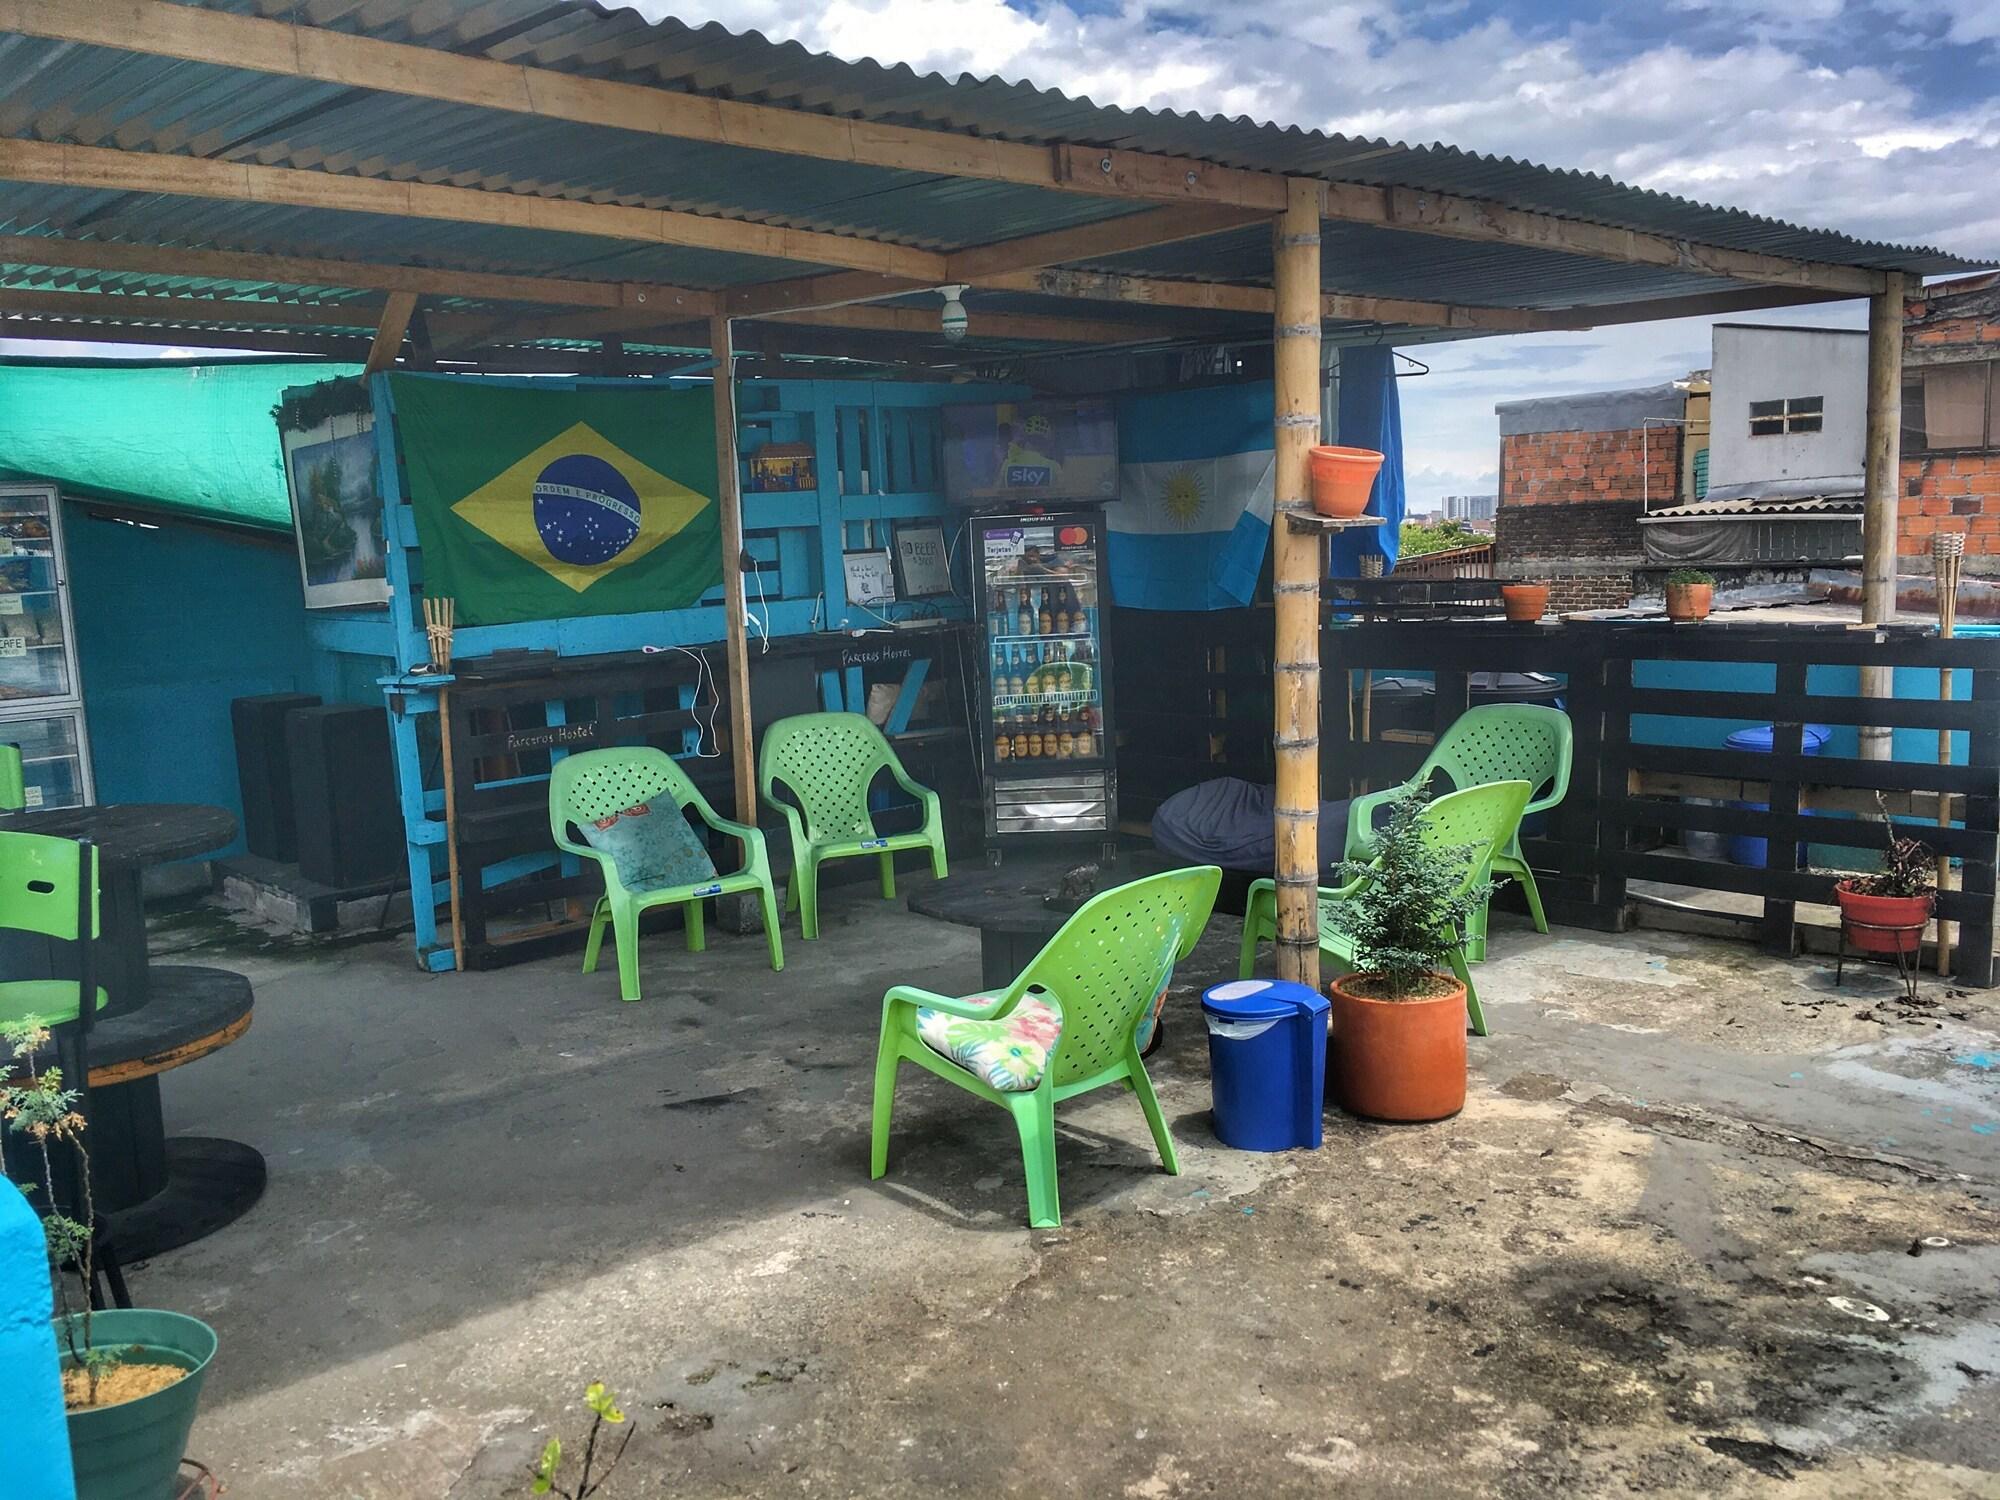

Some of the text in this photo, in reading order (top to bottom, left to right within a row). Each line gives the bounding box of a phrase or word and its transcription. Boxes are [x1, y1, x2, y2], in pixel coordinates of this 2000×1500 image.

[1012, 468, 1045, 485] sky
[535, 484, 570, 496] ORDEM
[586, 491, 641, 524] PROGRESSO
[914, 542, 936, 556] BEER
[987, 546, 1012, 555] Tarjetas
[508, 724, 594, 750] Parceros Hostel
